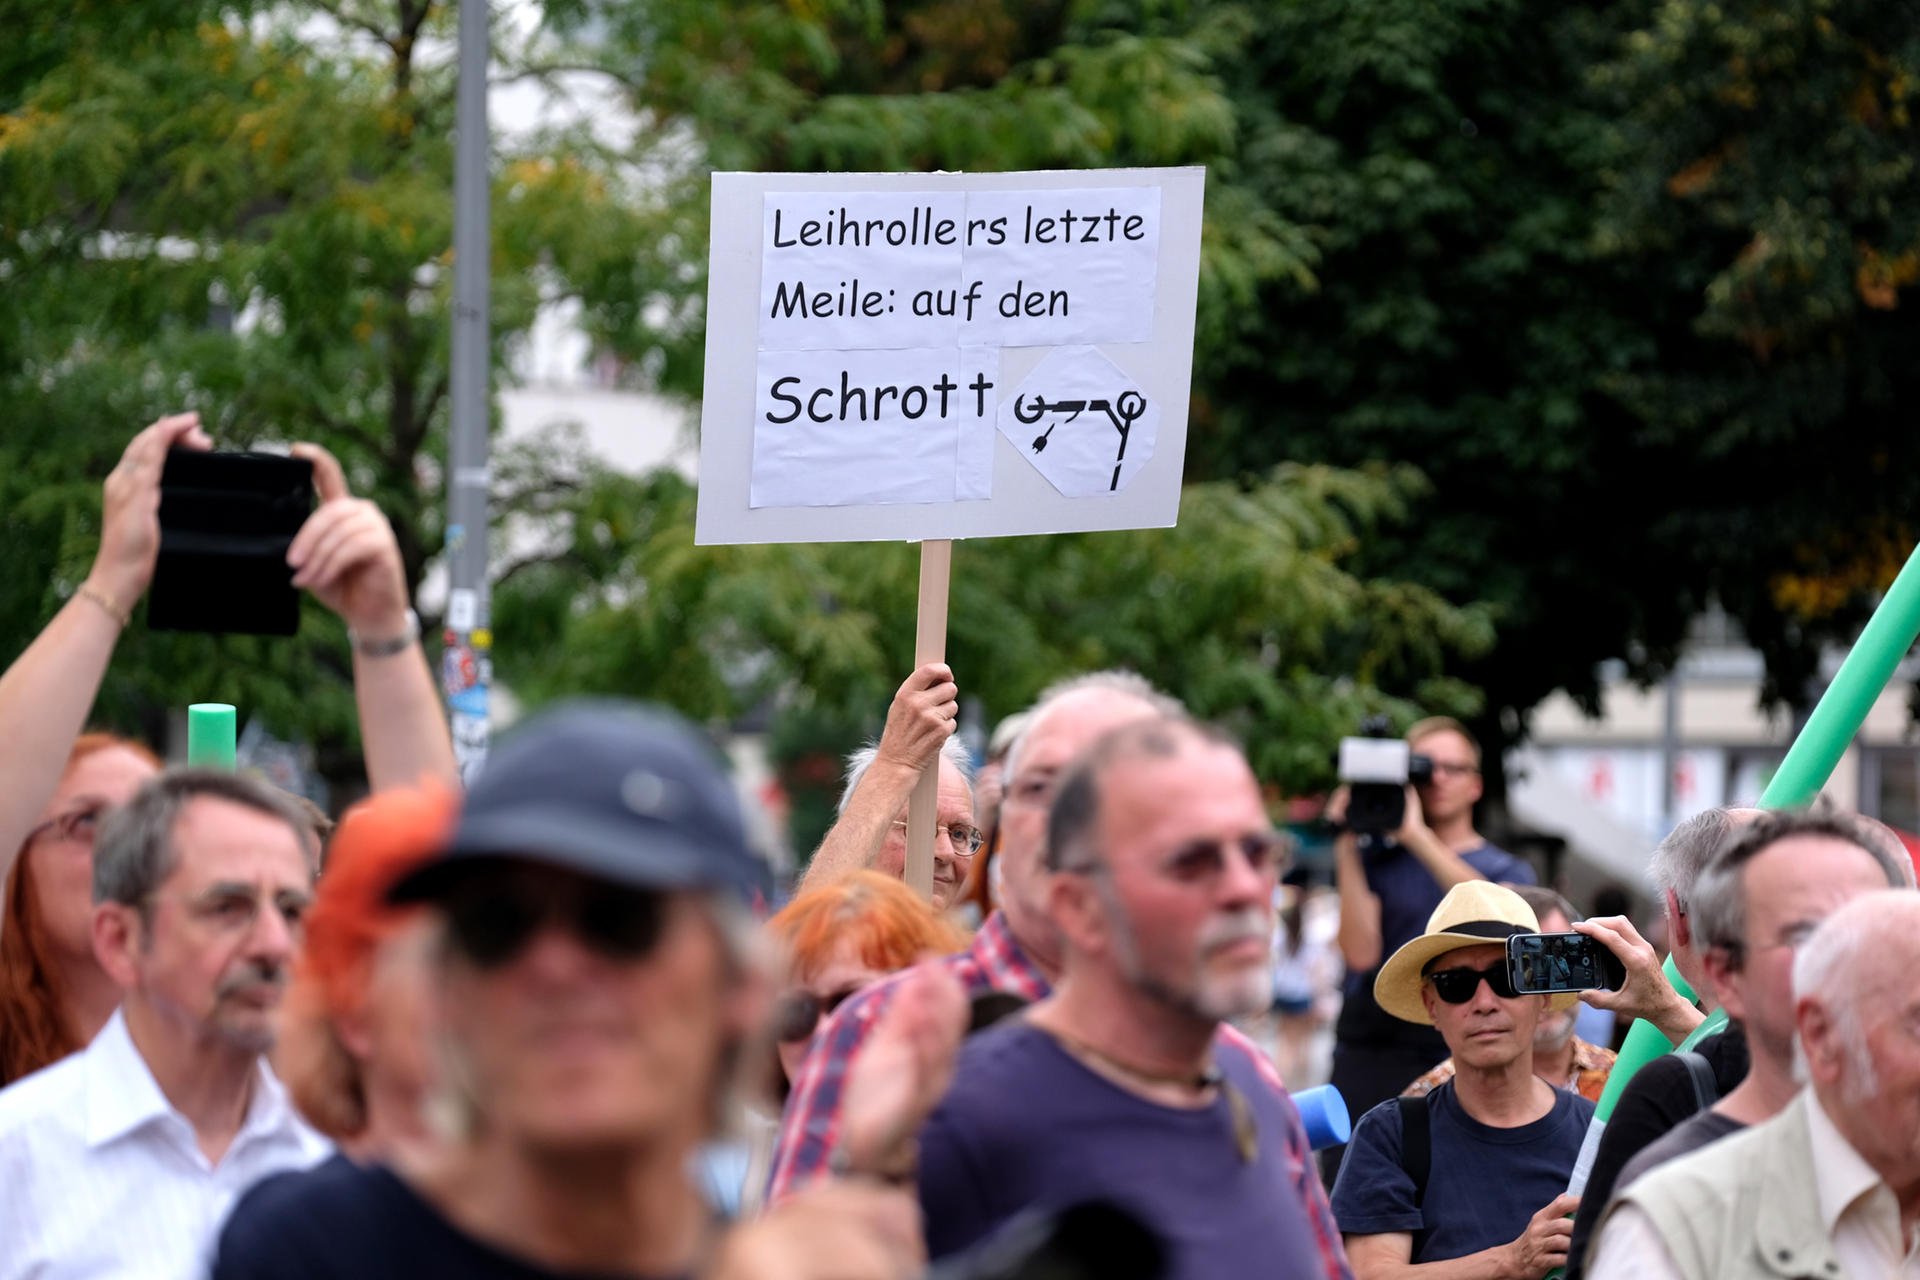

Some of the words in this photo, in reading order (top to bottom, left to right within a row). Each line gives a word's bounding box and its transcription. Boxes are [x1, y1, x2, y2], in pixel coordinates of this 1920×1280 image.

[773, 205, 1008, 248] Leihrollers
[1024, 205, 1146, 246] letzte
[770, 278, 896, 319] Meile:
[911, 279, 983, 322] auf
[998, 279, 1069, 318] den
[765, 370, 994, 424] Schrott
